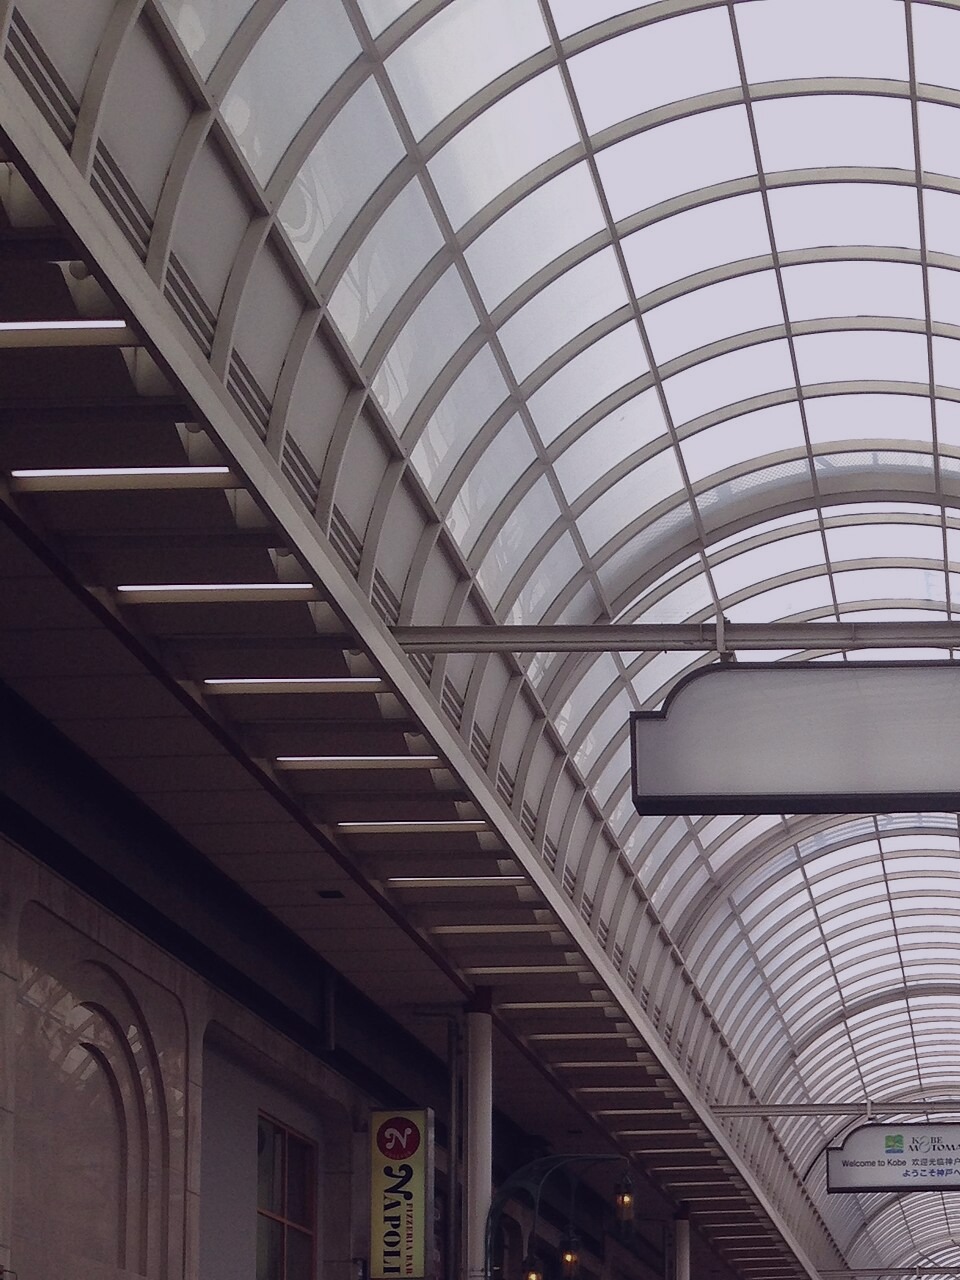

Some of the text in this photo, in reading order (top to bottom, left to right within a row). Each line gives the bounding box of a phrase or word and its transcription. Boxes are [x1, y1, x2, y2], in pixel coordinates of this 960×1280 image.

[841, 1159, 877, 1168] Welcome
[887, 1158, 907, 1167] Kobe
[383, 1163, 413, 1274] NAPOLI
[405, 1203, 414, 1274] PIZZERIA BAR
